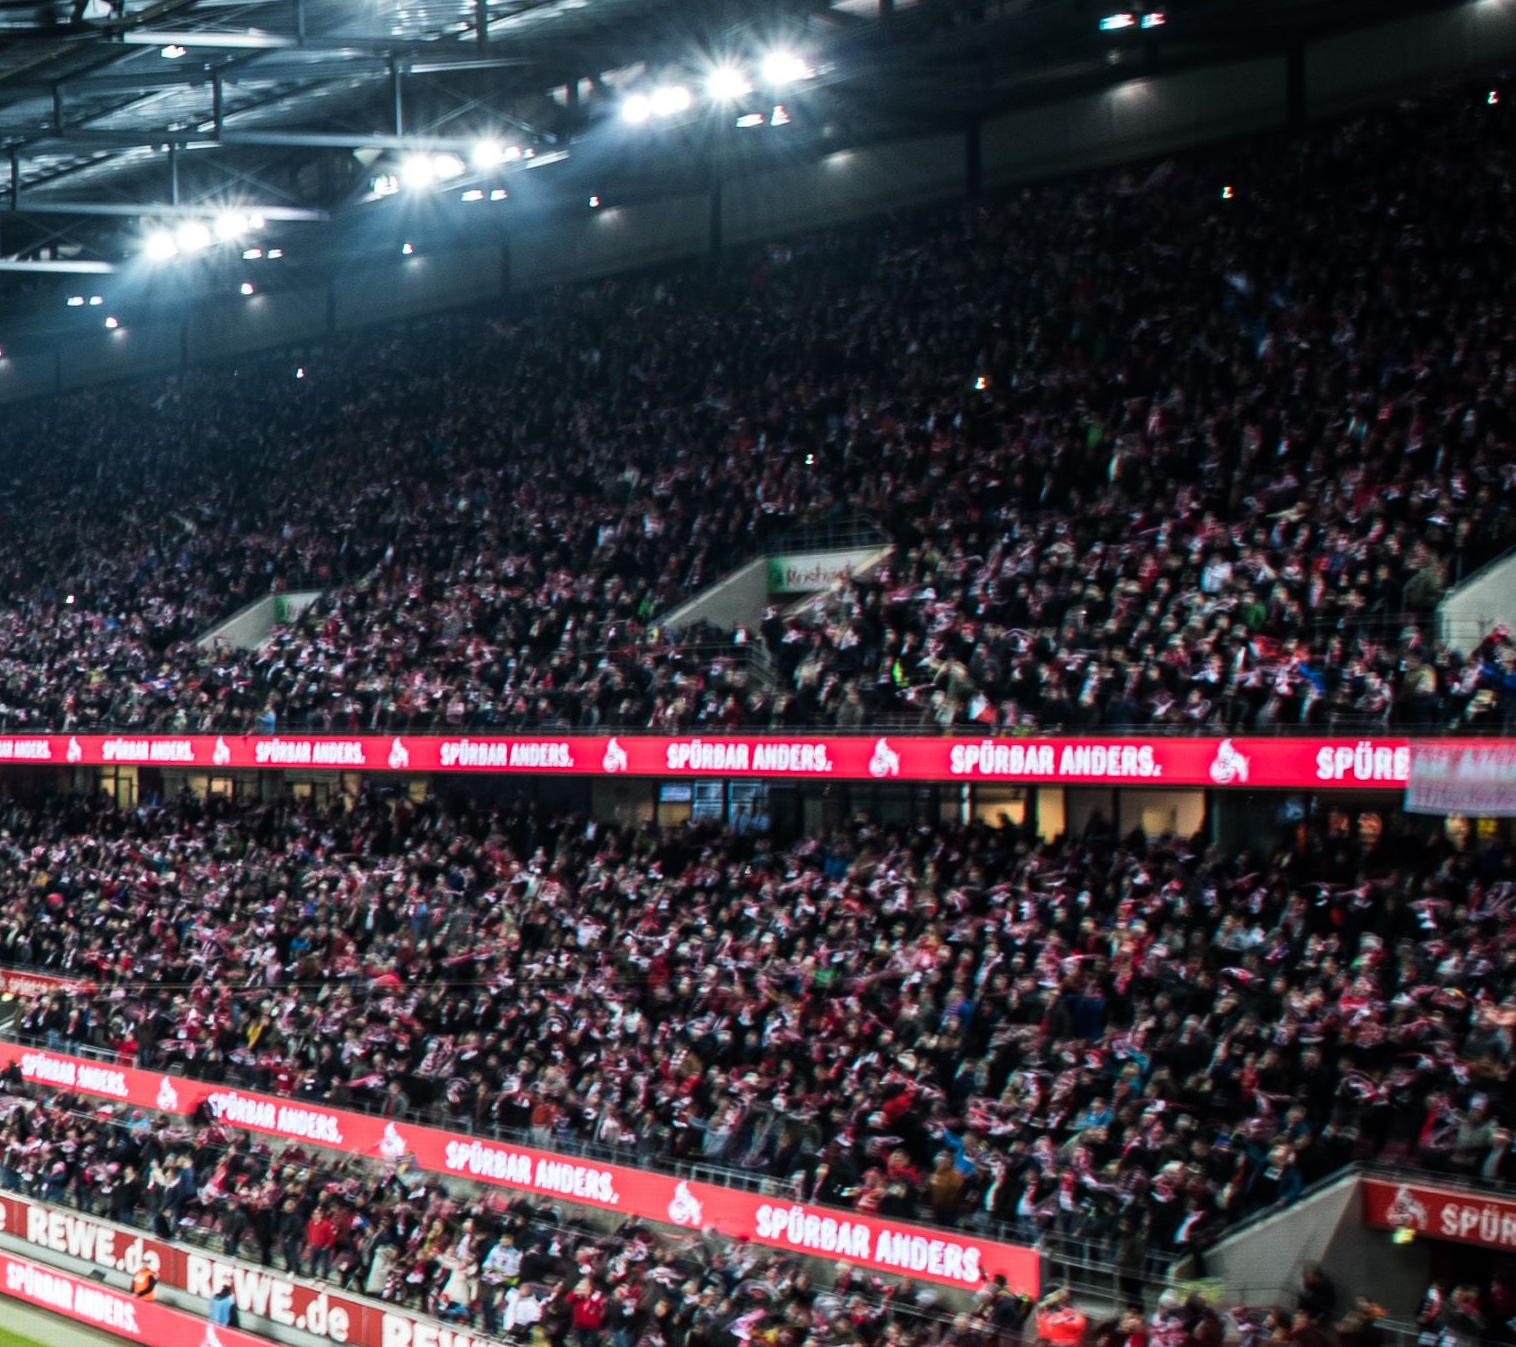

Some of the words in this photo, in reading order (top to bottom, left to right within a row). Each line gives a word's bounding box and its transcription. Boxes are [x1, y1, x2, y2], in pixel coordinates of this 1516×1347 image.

[102, 737, 149, 760] SPÜRBAR
[255, 737, 311, 763] SPÜRBAR
[440, 738, 507, 767] SPÜRBAR
[509, 742, 574, 768] ANDERS.
[666, 738, 748, 770] SPÜRBAR
[752, 743, 832, 771] ANDERS.
[950, 739, 1054, 776] SPÜRBAR
[1059, 745, 1161, 778] ANDERS.
[208, 1089, 277, 1131] SPÜRBAR
[445, 1140, 532, 1188] SPÜRBAR
[535, 1158, 620, 1205] ANDERS.
[26, 1206, 161, 1275] REWE.de
[755, 1204, 871, 1260] SPÜRBAR
[875, 1229, 983, 1284] ANDERS
[5, 1259, 73, 1315] SPÜRBAR
[186, 1253, 351, 1344] REWE.de
